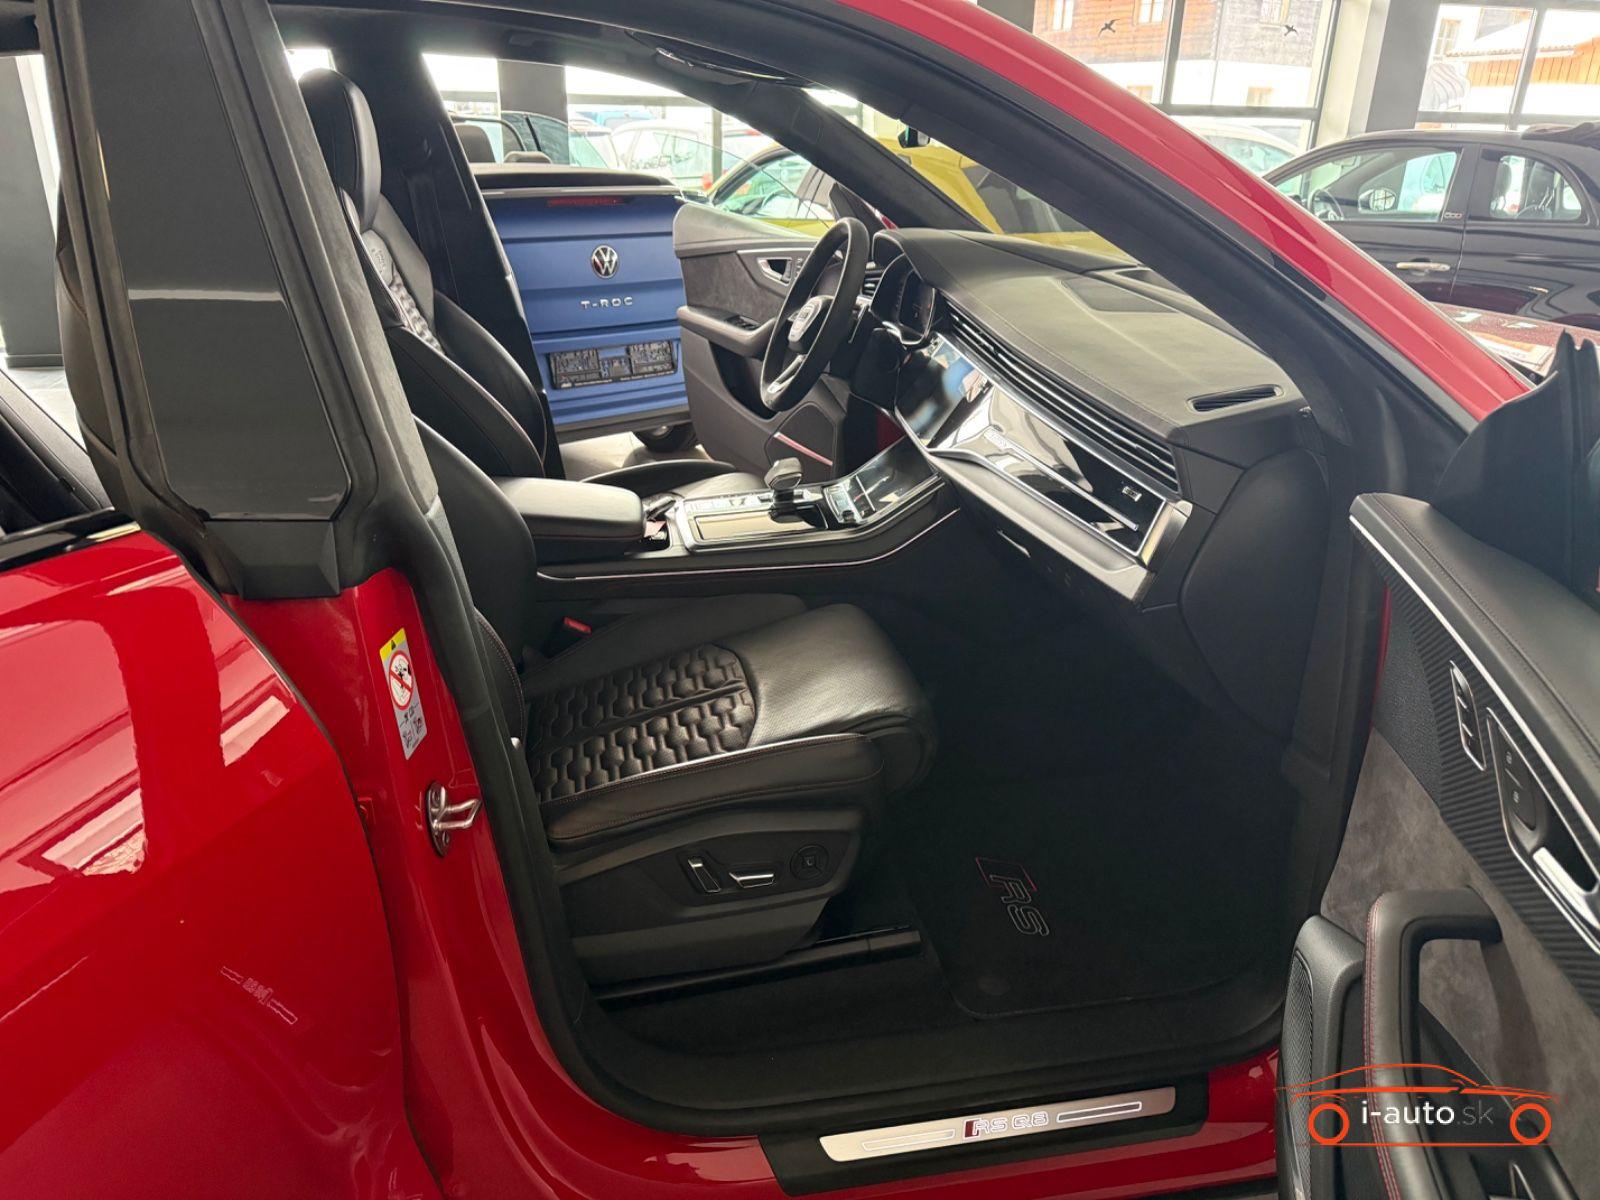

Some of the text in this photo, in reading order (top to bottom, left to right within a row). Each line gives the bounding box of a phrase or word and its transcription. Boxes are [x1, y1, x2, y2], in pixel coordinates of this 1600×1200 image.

[580, 296, 633, 309] T-ROC
[987, 872, 1049, 936] RS
[969, 1111, 1049, 1137] RS Q8
